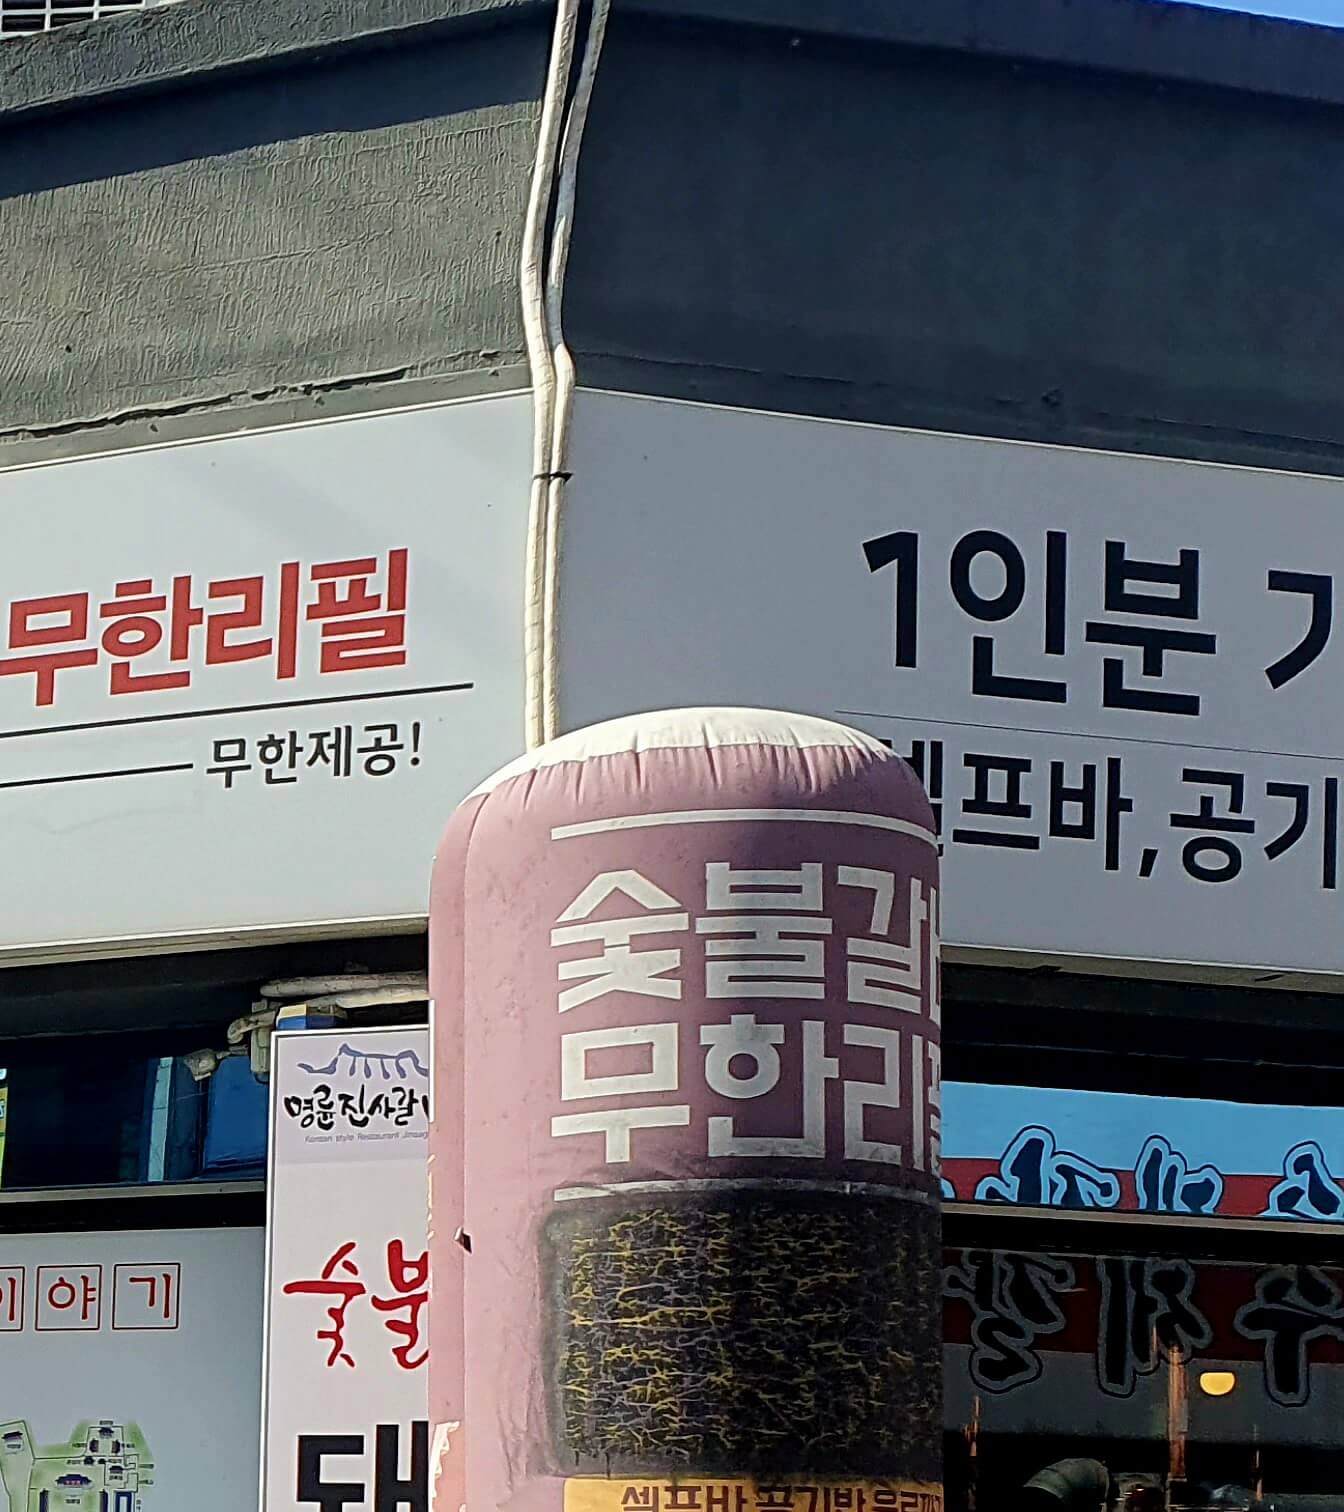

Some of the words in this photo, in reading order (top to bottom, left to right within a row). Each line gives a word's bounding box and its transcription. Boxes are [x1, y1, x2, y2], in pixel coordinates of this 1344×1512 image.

[861, 528, 1217, 717] 1인분
[205, 722, 422, 789] 무한제공!
[284, 1084, 428, 1130] 명륜진사갈
[283, 1239, 429, 1370] 숯불
